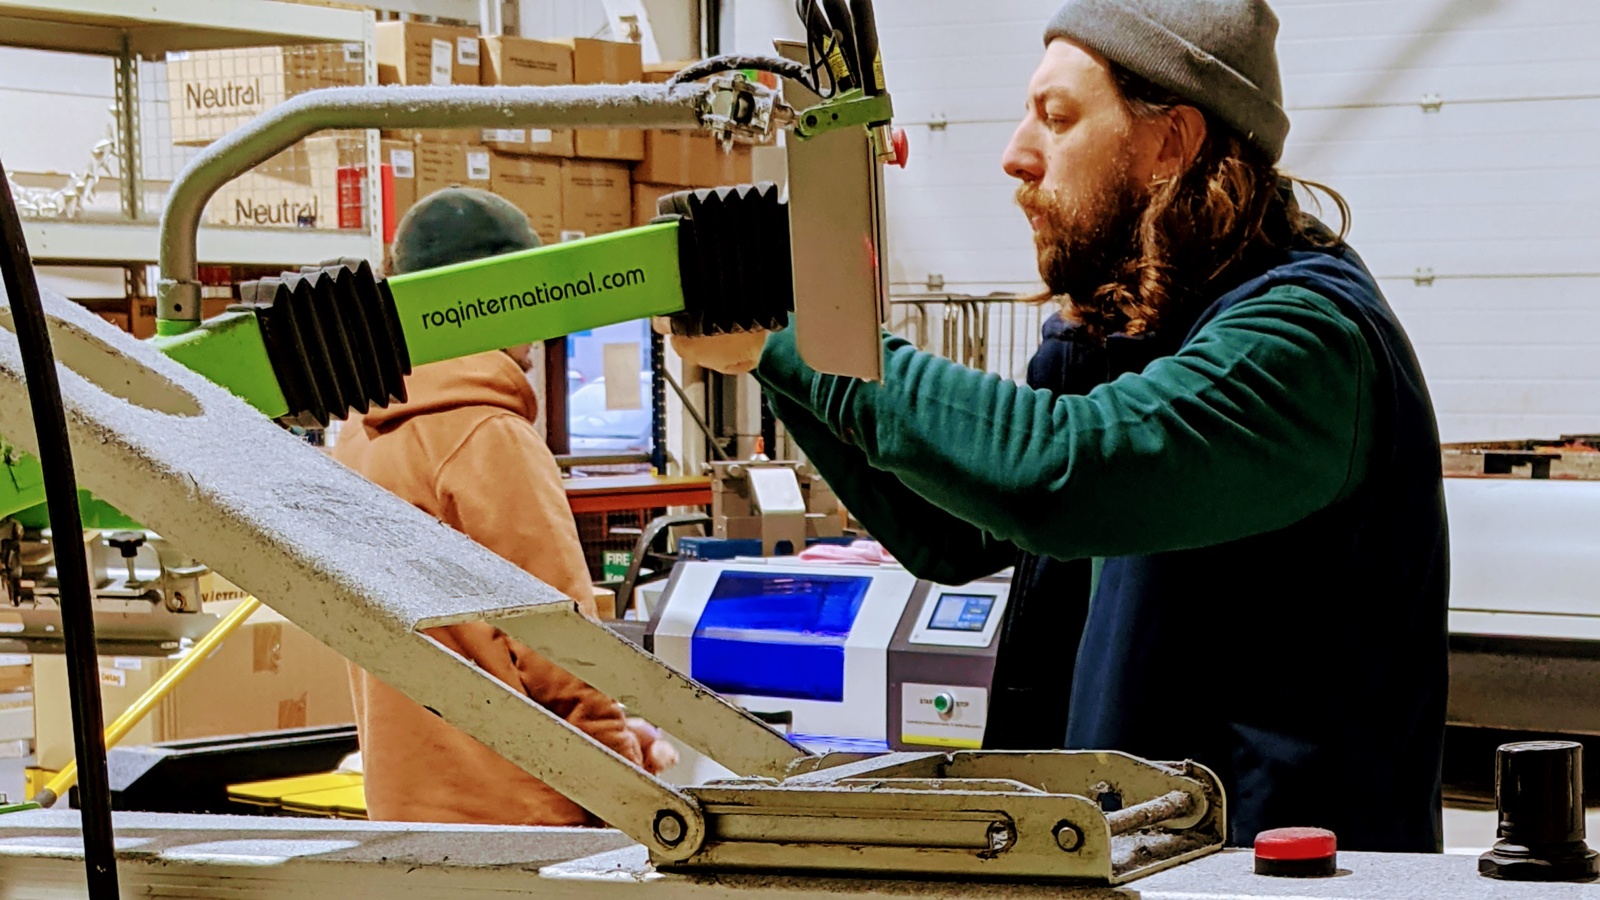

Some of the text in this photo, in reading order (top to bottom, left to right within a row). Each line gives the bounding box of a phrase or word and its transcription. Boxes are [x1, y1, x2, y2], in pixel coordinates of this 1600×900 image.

[186, 77, 260, 111] Neutral
[236, 195, 318, 225] Neutral
[422, 268, 646, 329] roqinternational.com
[605, 552, 630, 566] FIRE
